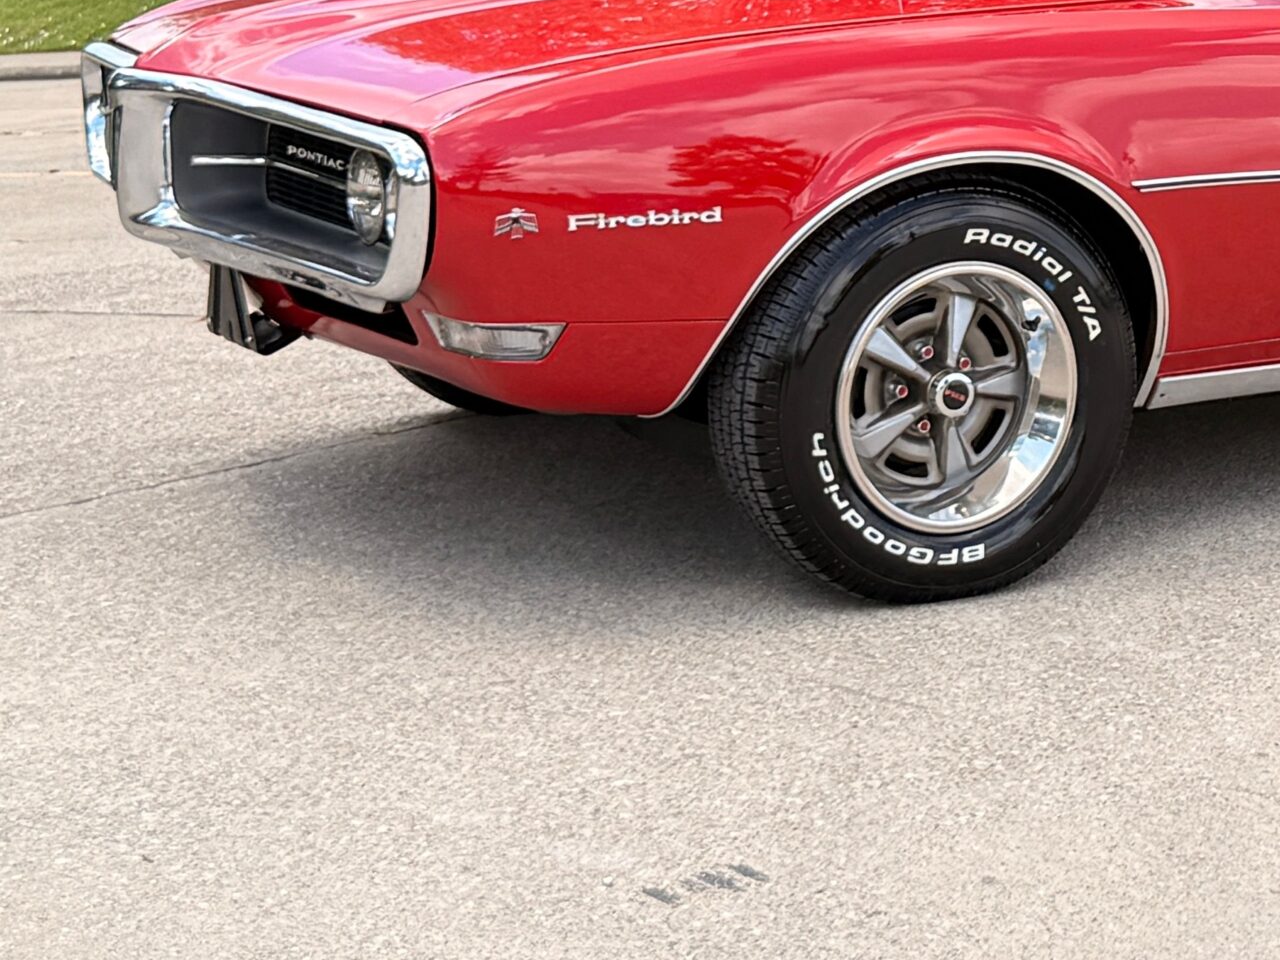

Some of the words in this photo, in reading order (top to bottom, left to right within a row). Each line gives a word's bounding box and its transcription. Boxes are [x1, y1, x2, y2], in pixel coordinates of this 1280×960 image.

[286, 145, 345, 171] PONTIAC
[567, 206, 723, 232] Firebird
[963, 227, 1072, 284] Radial
[1072, 285, 1102, 342] T/A
[812, 432, 986, 566] BFGoodrich
